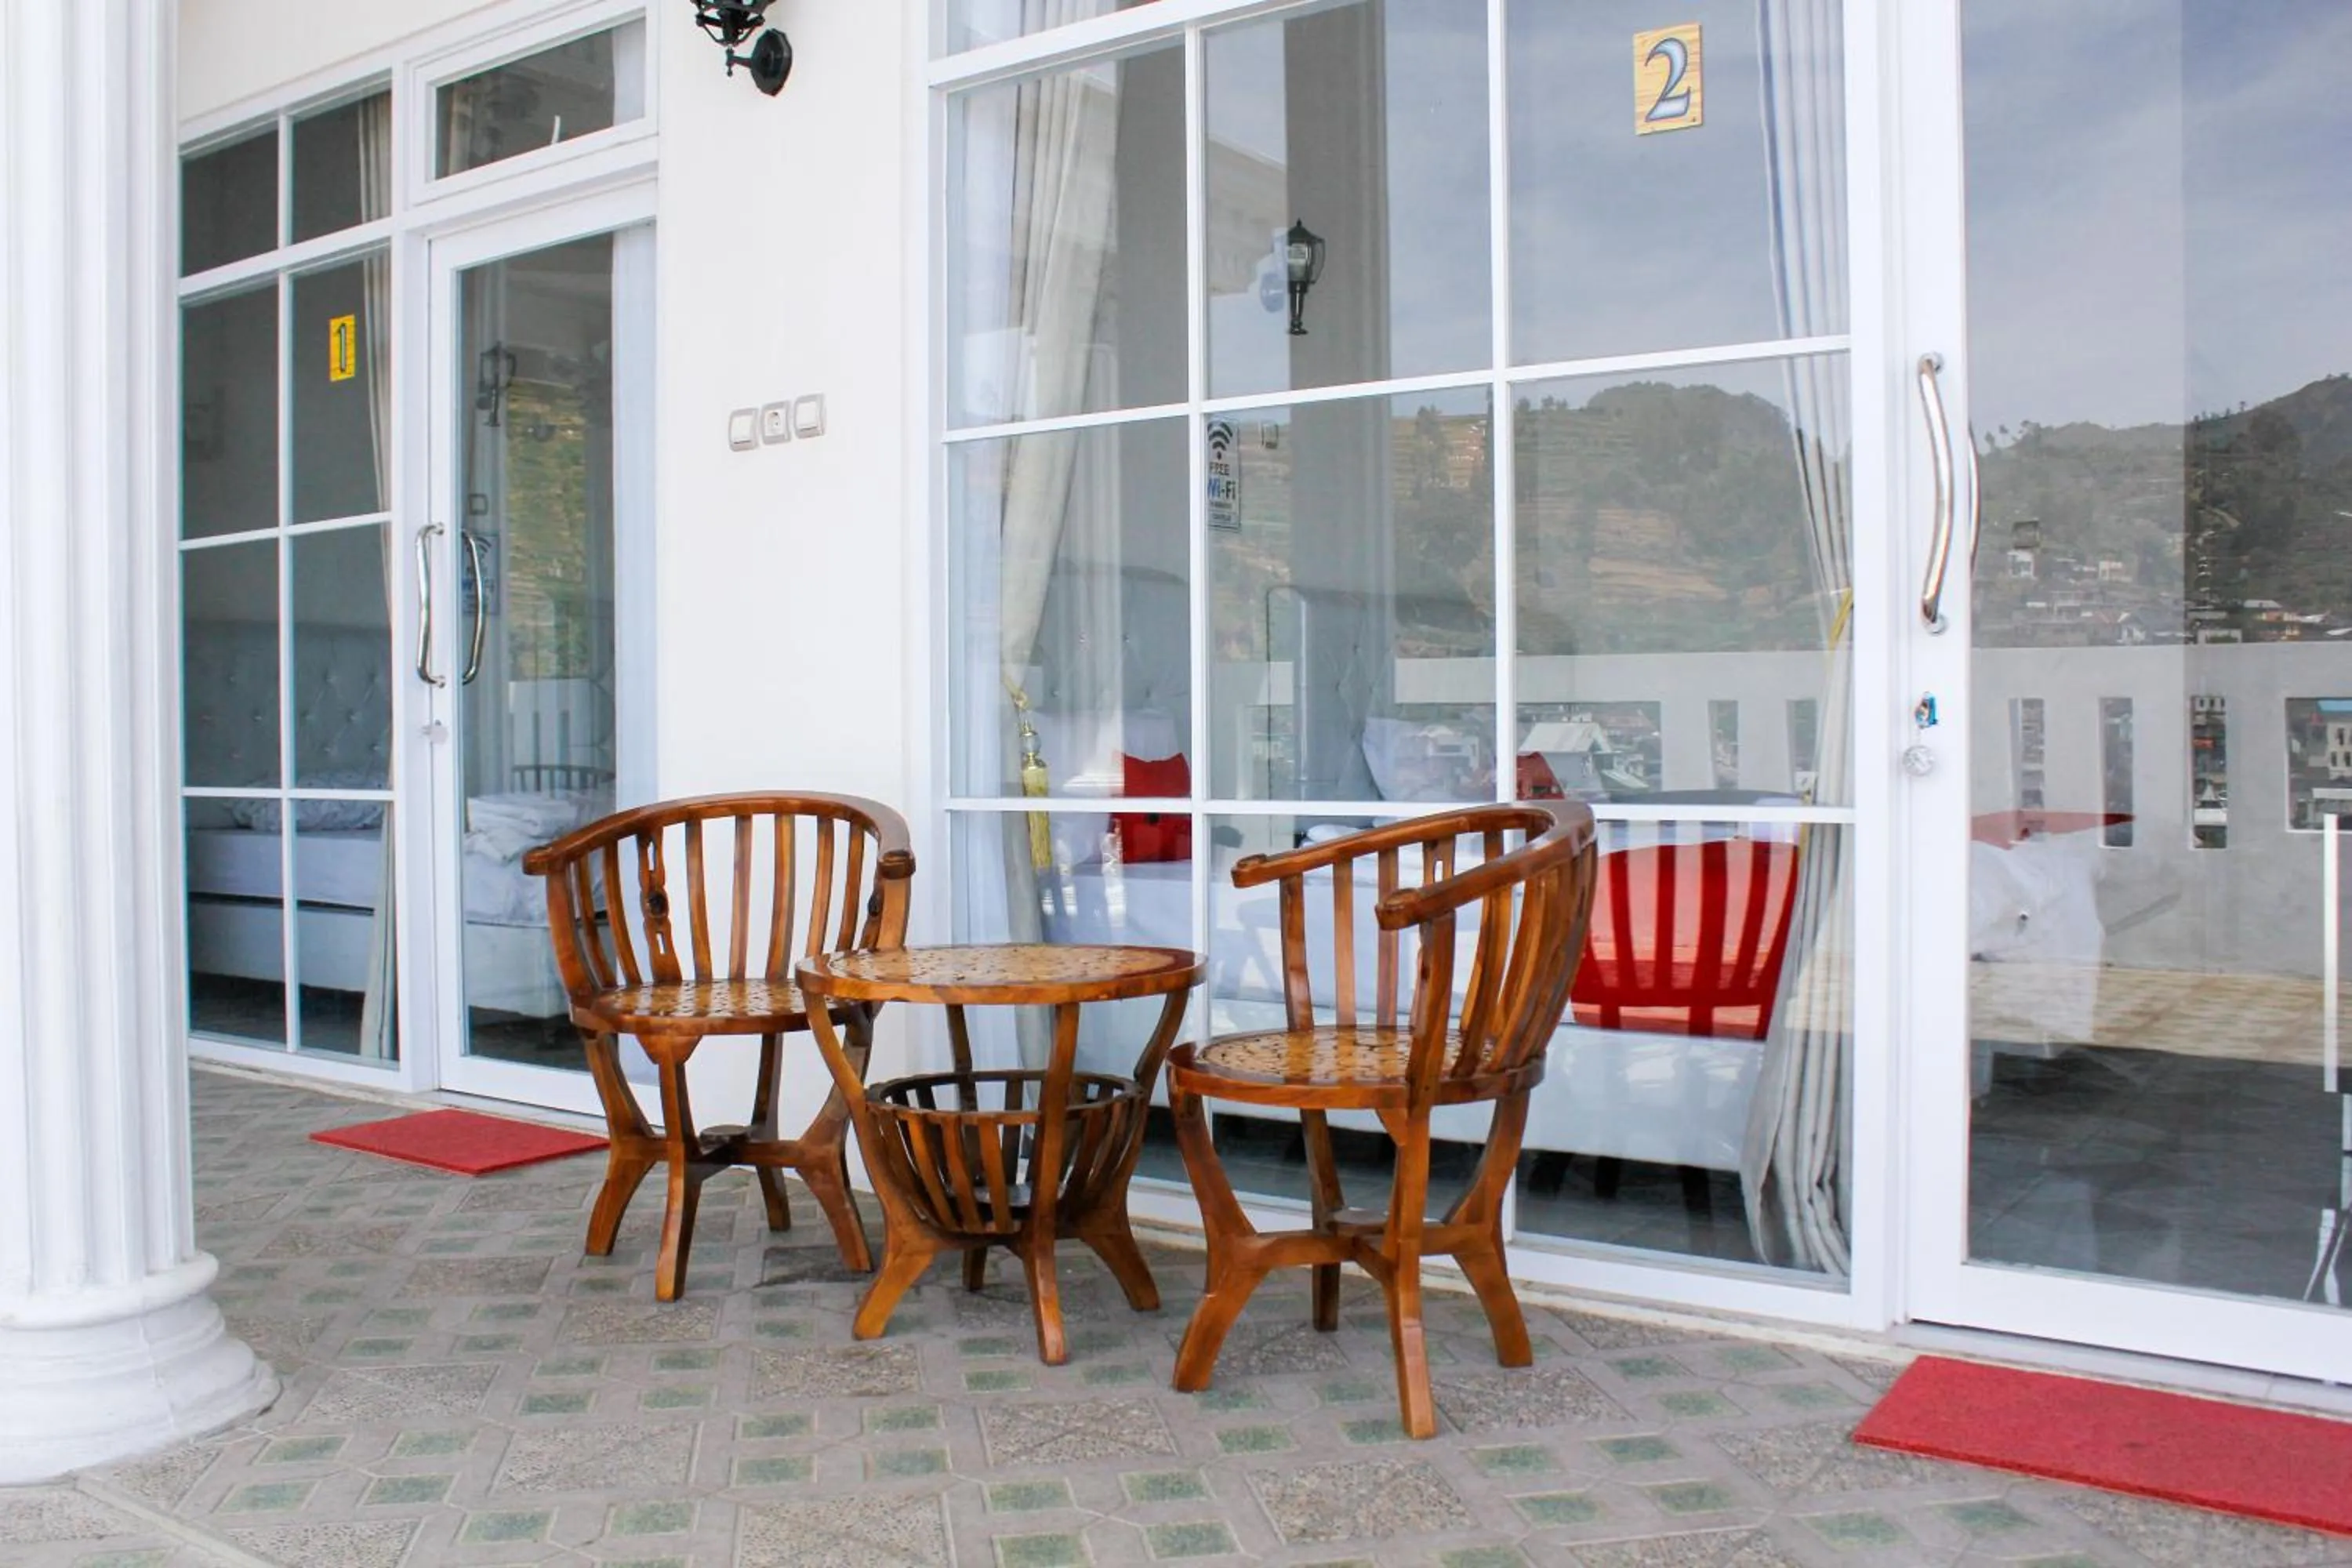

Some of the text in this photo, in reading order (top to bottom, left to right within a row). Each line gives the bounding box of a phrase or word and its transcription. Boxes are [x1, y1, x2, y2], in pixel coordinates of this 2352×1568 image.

[1644, 37, 1691, 122] 2
[335, 322, 347, 373] 1
[1209, 462, 1230, 476] FREE
